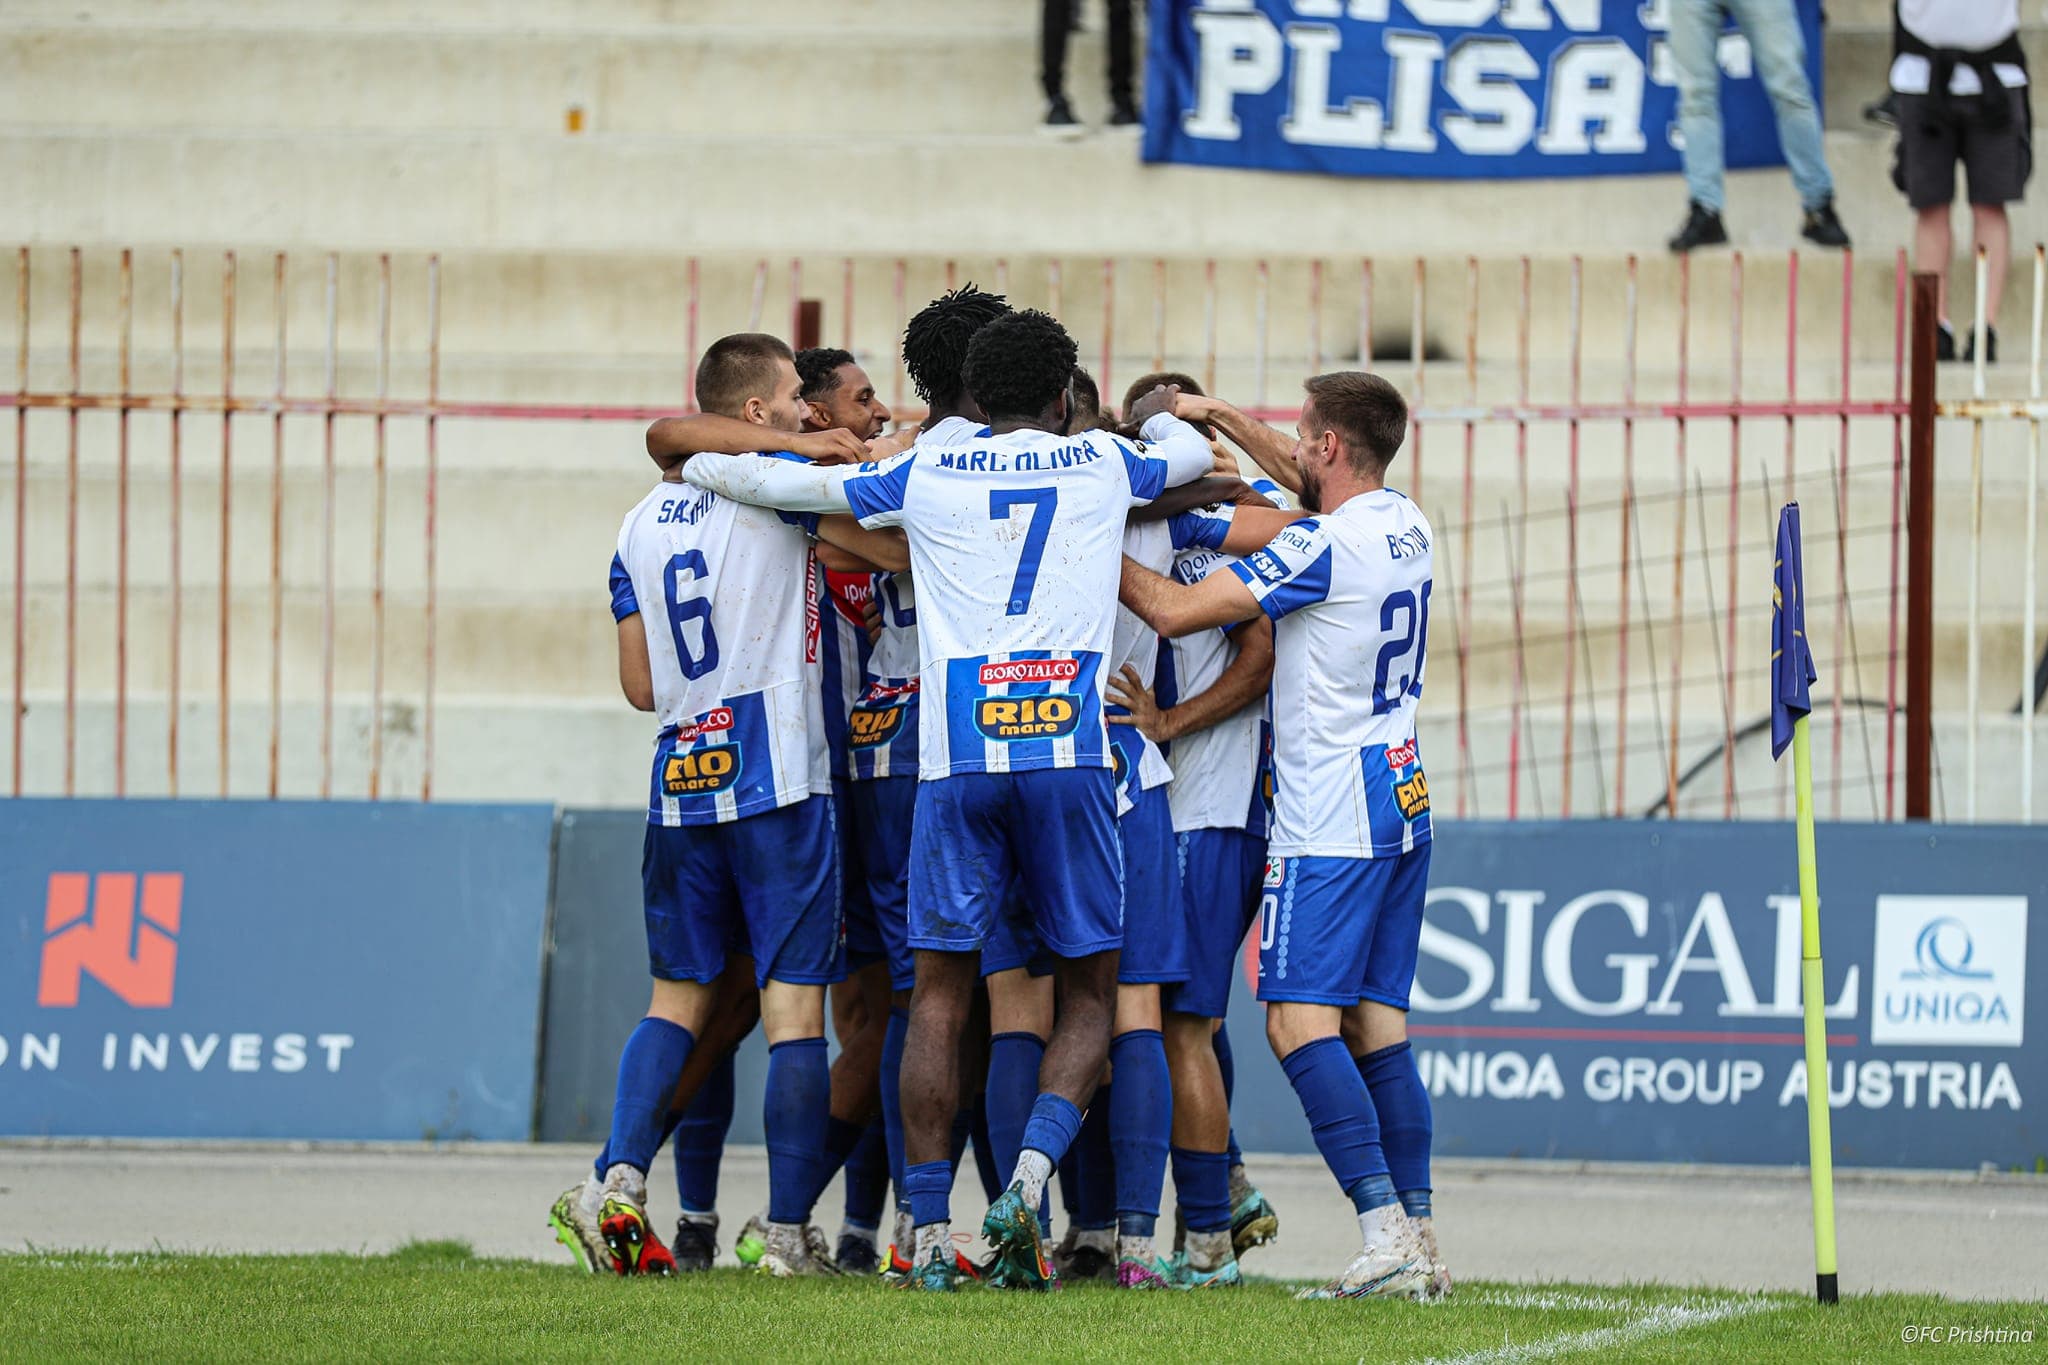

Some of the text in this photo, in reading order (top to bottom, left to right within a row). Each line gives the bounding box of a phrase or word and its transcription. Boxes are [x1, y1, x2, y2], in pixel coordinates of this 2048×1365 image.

[1015, 440, 1103, 472] OLIVER
[989, 487, 1058, 616] 7
[663, 549, 719, 682] 6
[983, 663, 1076, 681] BOROTALCO
[851, 707, 899, 734] RIO
[982, 698, 1072, 726] RIO
[999, 723, 1058, 735] mare
[665, 750, 733, 781] RIO
[669, 777, 720, 791] mare
[1397, 771, 1428, 810] RIO
[1407, 886, 1859, 1019] SIGAL
[1884, 991, 2011, 1026] UNIQA
[0, 1032, 354, 1072] N INVEST
[1583, 1056, 1765, 1104] GROUP
[1779, 1059, 2022, 1110] AUSTRIA
